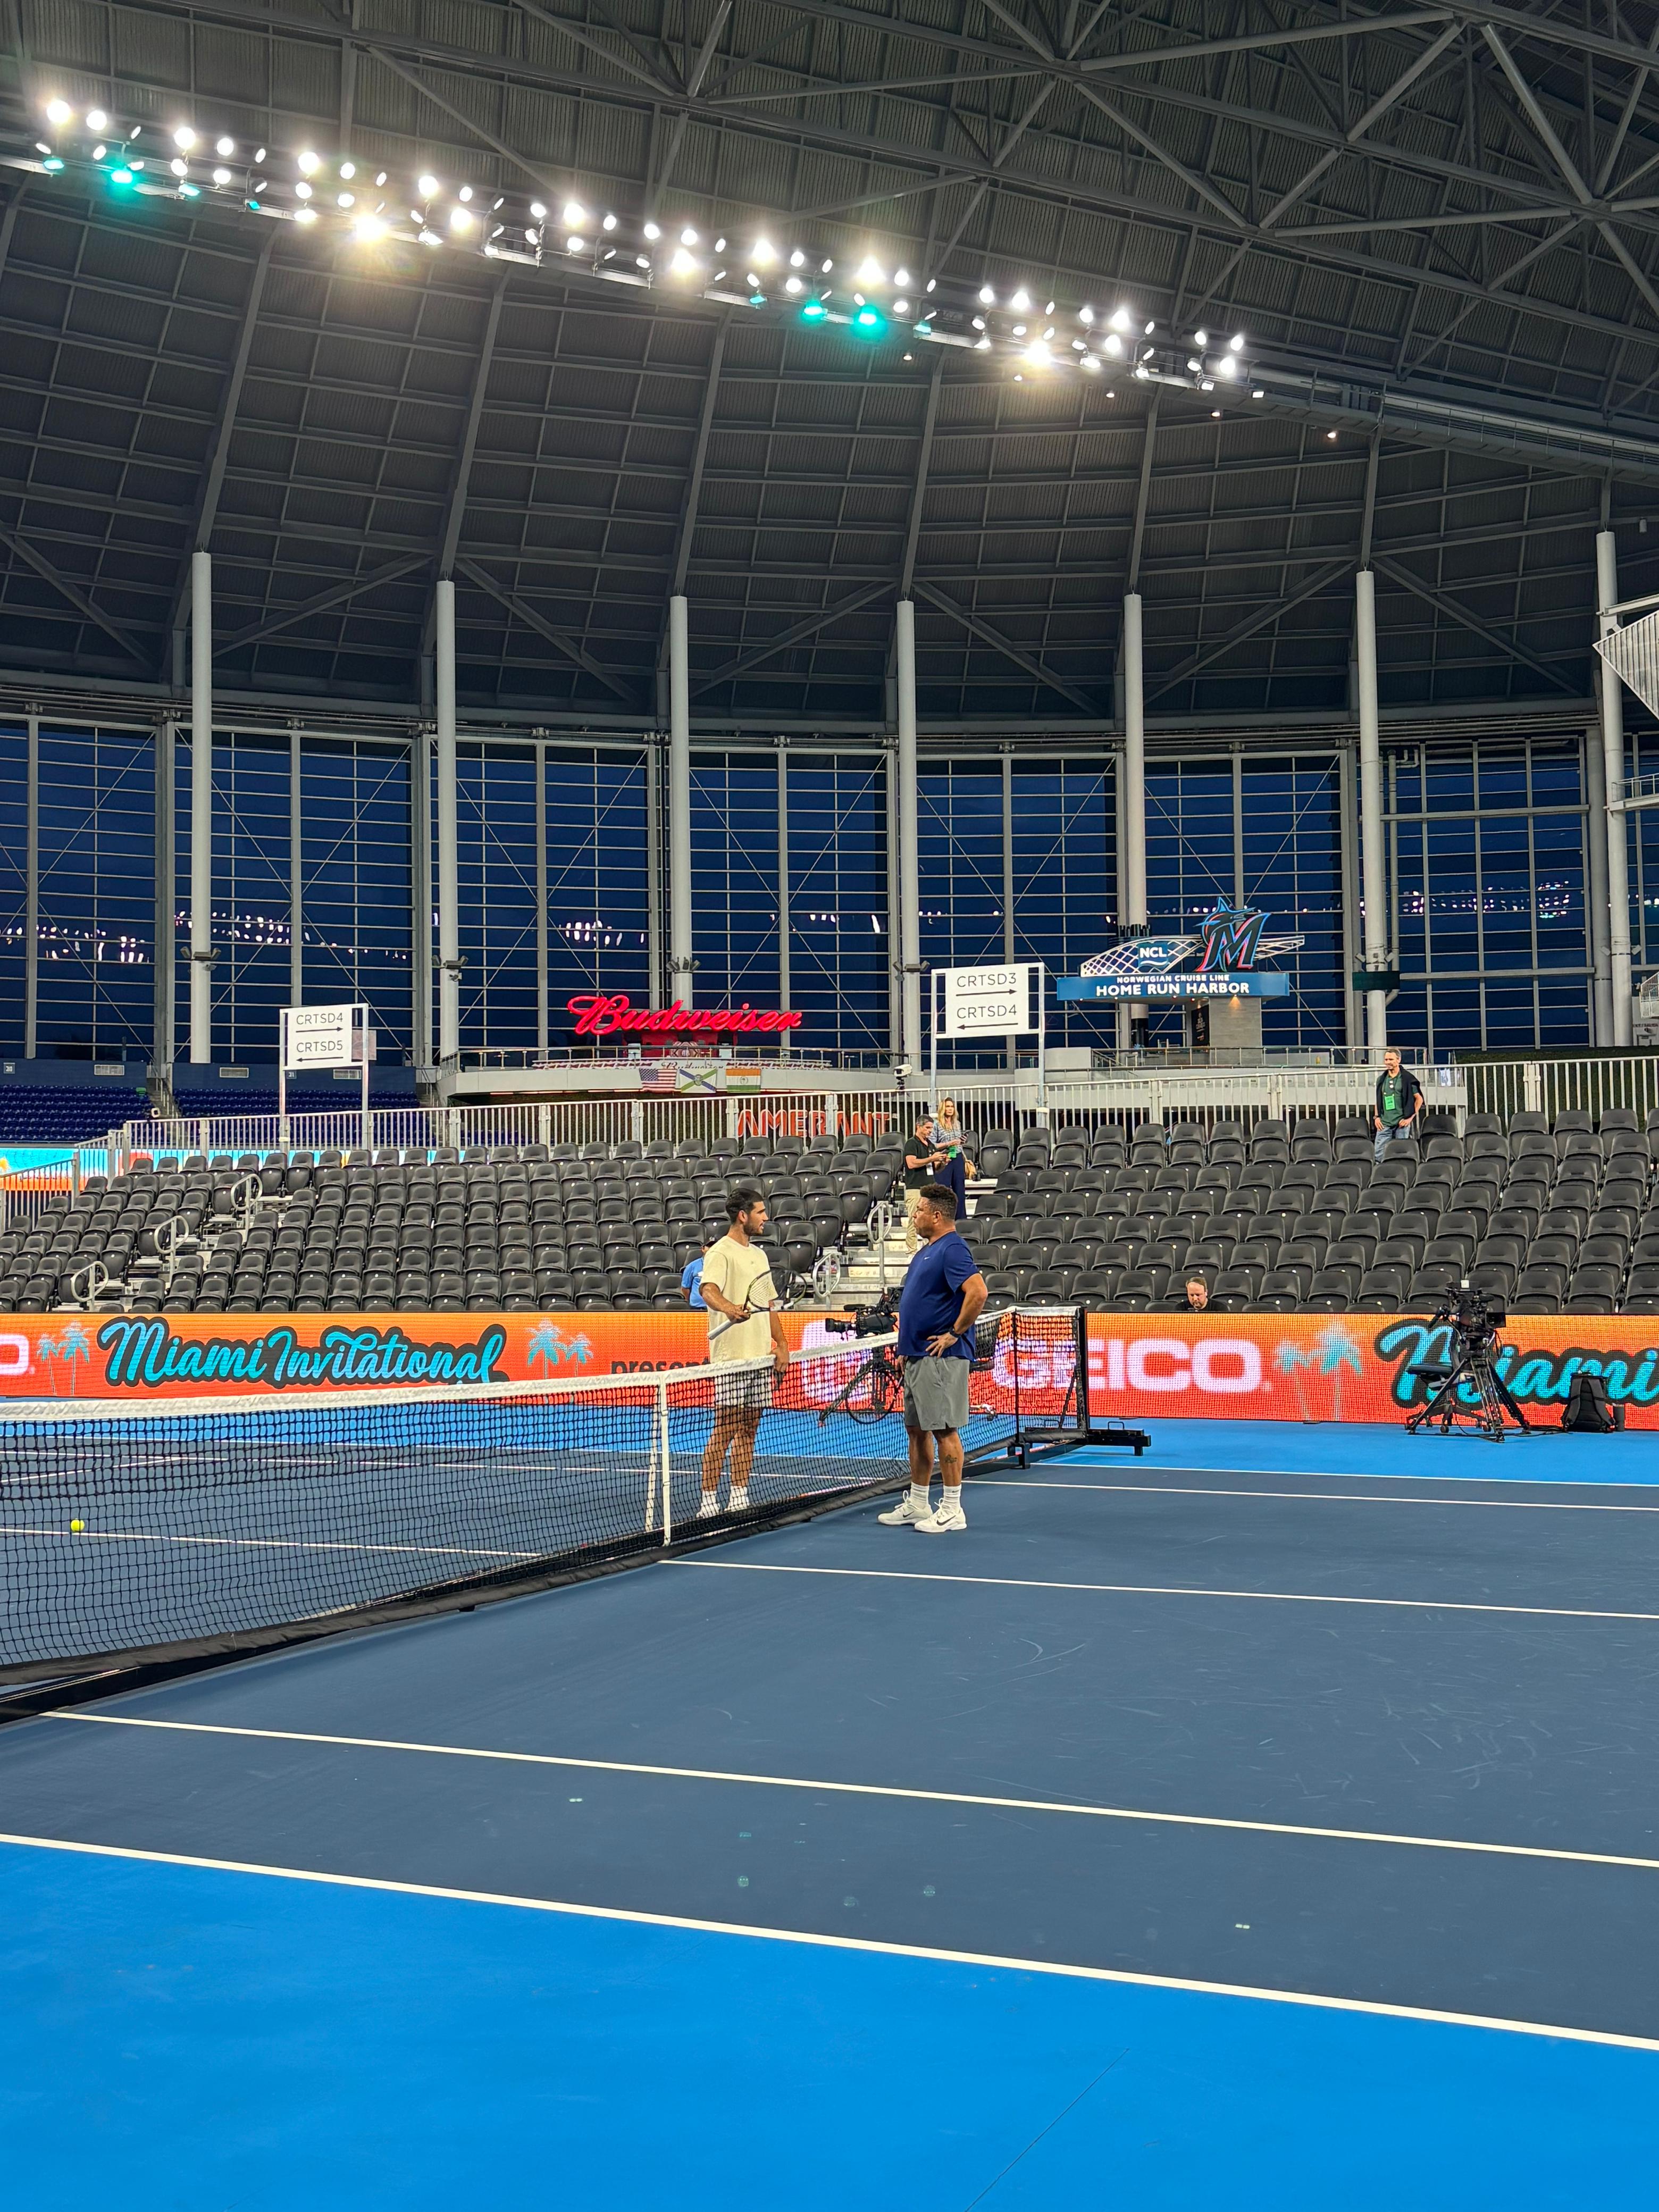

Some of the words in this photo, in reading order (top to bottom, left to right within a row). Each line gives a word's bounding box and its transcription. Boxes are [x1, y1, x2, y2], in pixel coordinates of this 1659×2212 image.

[1139, 946, 1167, 958] NCL
[957, 973, 1016, 987] CRTSD3
[1117, 975, 1172, 984] NORWEGIAN
[1096, 984, 1141, 996] HOME
[1147, 983, 1180, 995] RUN
[1186, 982, 1250, 994] HARBOR
[296, 1012, 343, 1025] CRTSD4
[567, 995, 802, 1036] Budweiser
[957, 1004, 1017, 1019] CRTSD4
[296, 1040, 343, 1052] CRTSD5
[100, 1322, 267, 1381] Miami
[267, 1330, 502, 1384] Invitational
[992, 1338, 1262, 1393] GEICO
